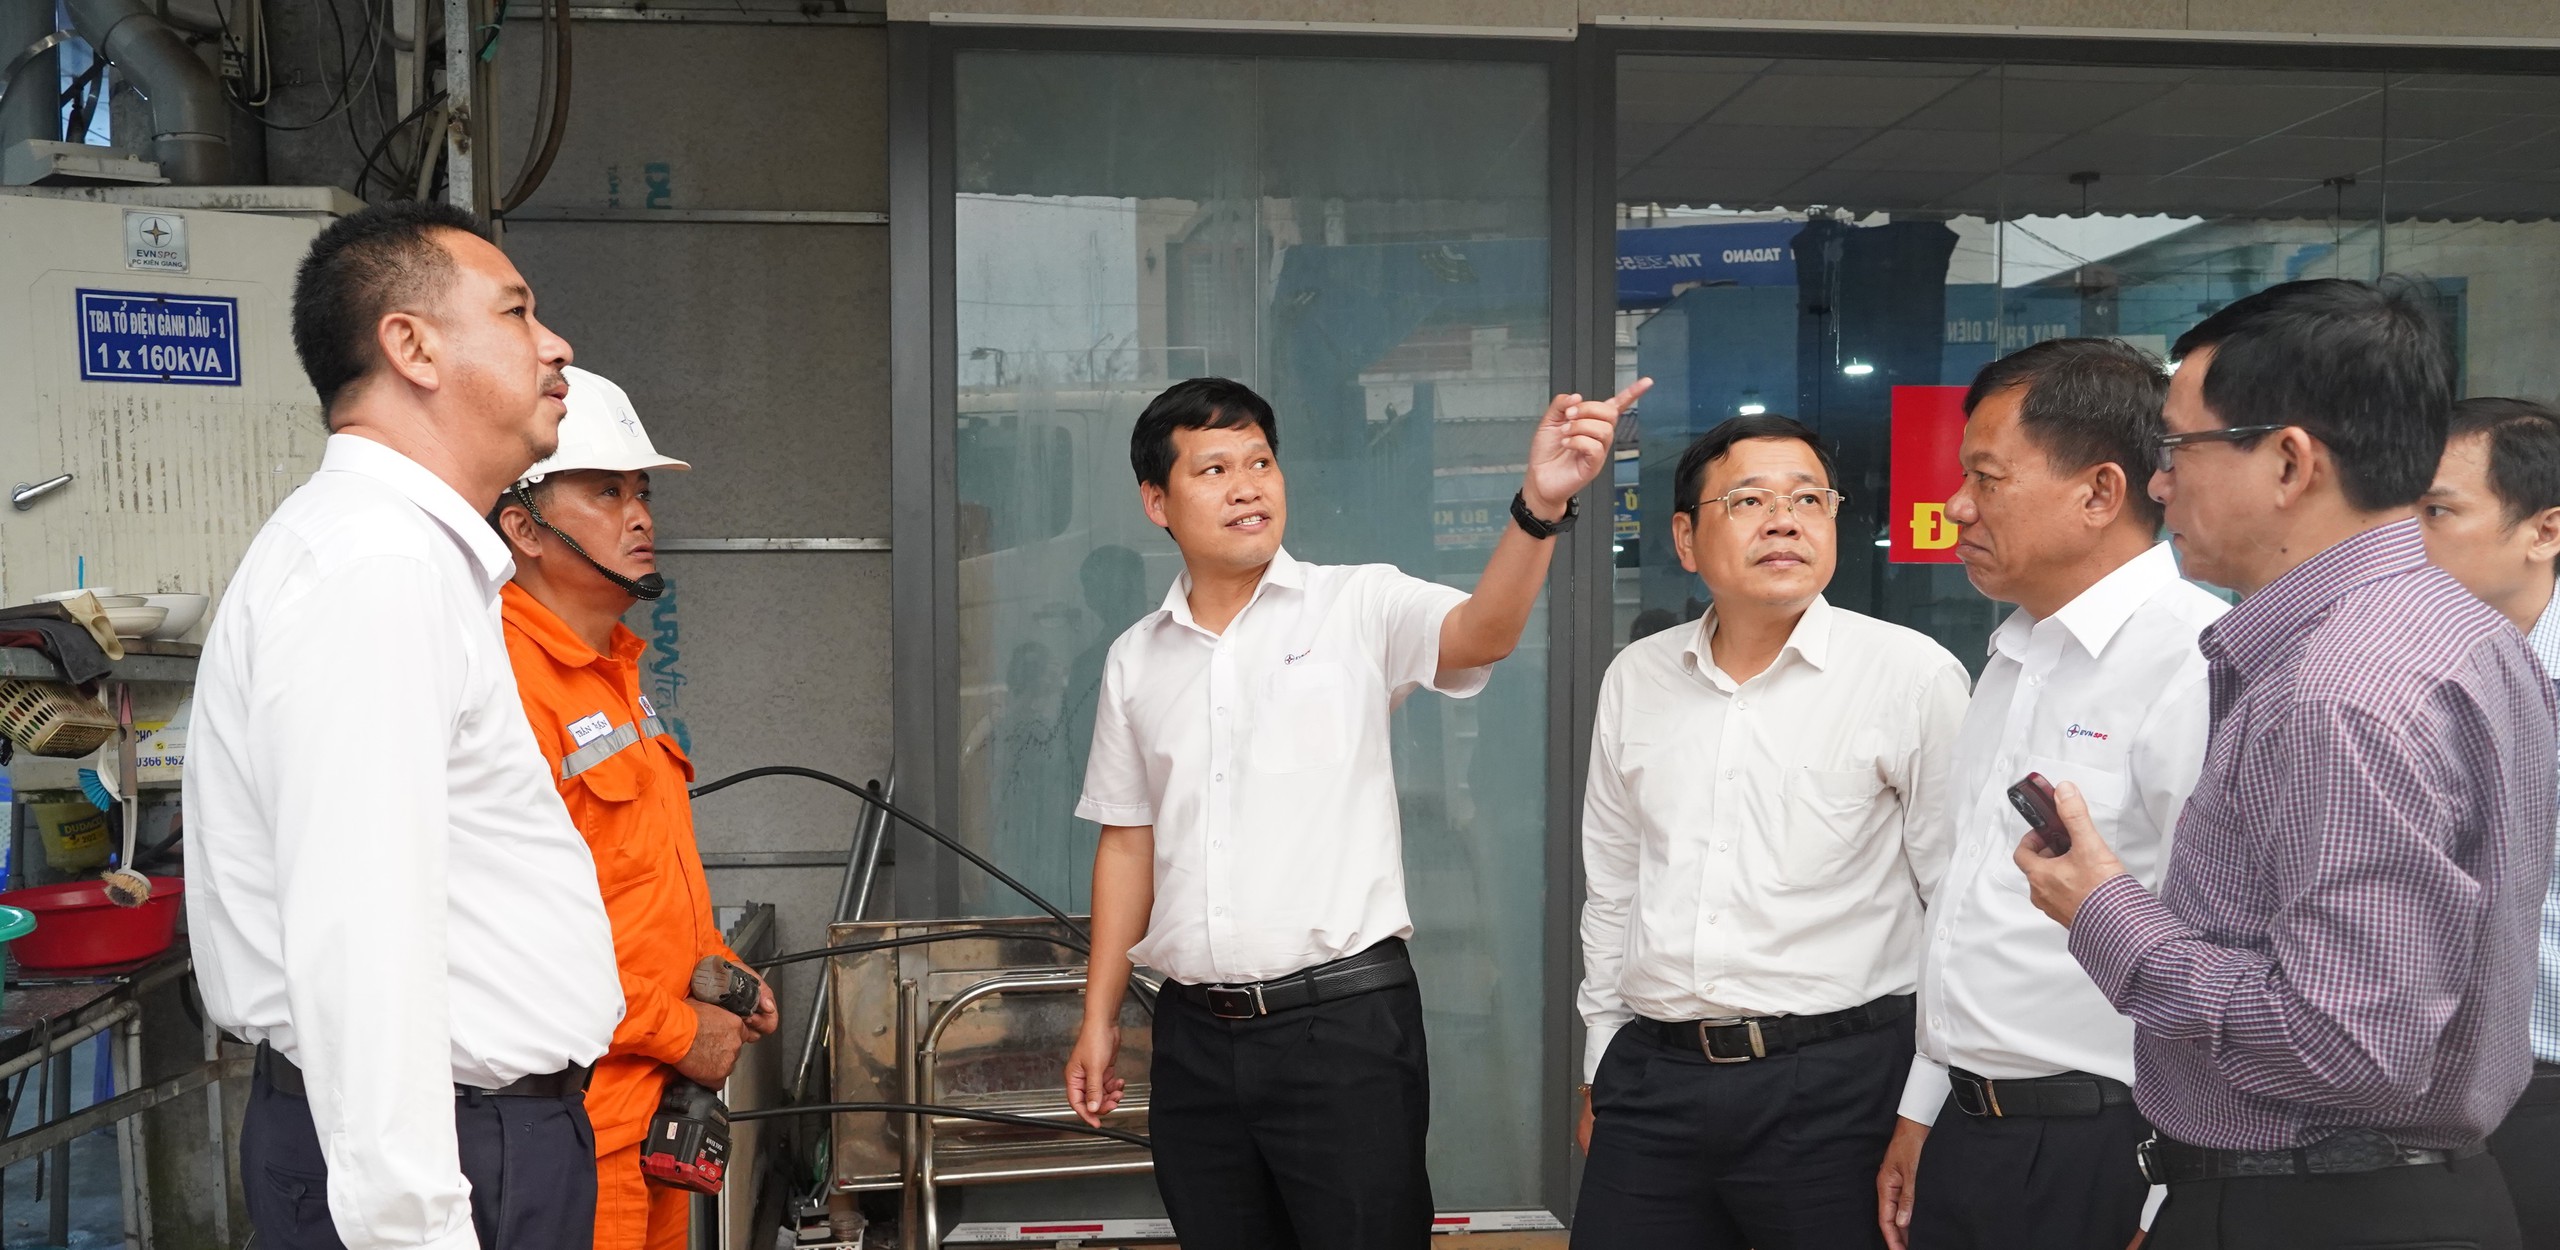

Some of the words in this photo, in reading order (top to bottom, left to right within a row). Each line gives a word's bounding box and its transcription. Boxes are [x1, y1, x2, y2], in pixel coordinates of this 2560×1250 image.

[136, 249, 178, 260] EVNSPC
[160, 260, 183, 268] GIANG
[89, 309, 111, 334] TBA
[112, 300, 128, 335] TỔ
[130, 307, 156, 339] ĐIỆN
[157, 308, 186, 337] GÀNH
[188, 306, 210, 338] DẦU
[218, 317, 226, 339] 1
[97, 342, 109, 369] 1
[117, 349, 132, 370] x
[137, 344, 223, 373] 160kVA
[1909, 502, 1959, 550] Đ
[2080, 729, 2108, 740] EVNSPC
[136, 756, 162, 767] 0366
[165, 755, 185, 766] 962
